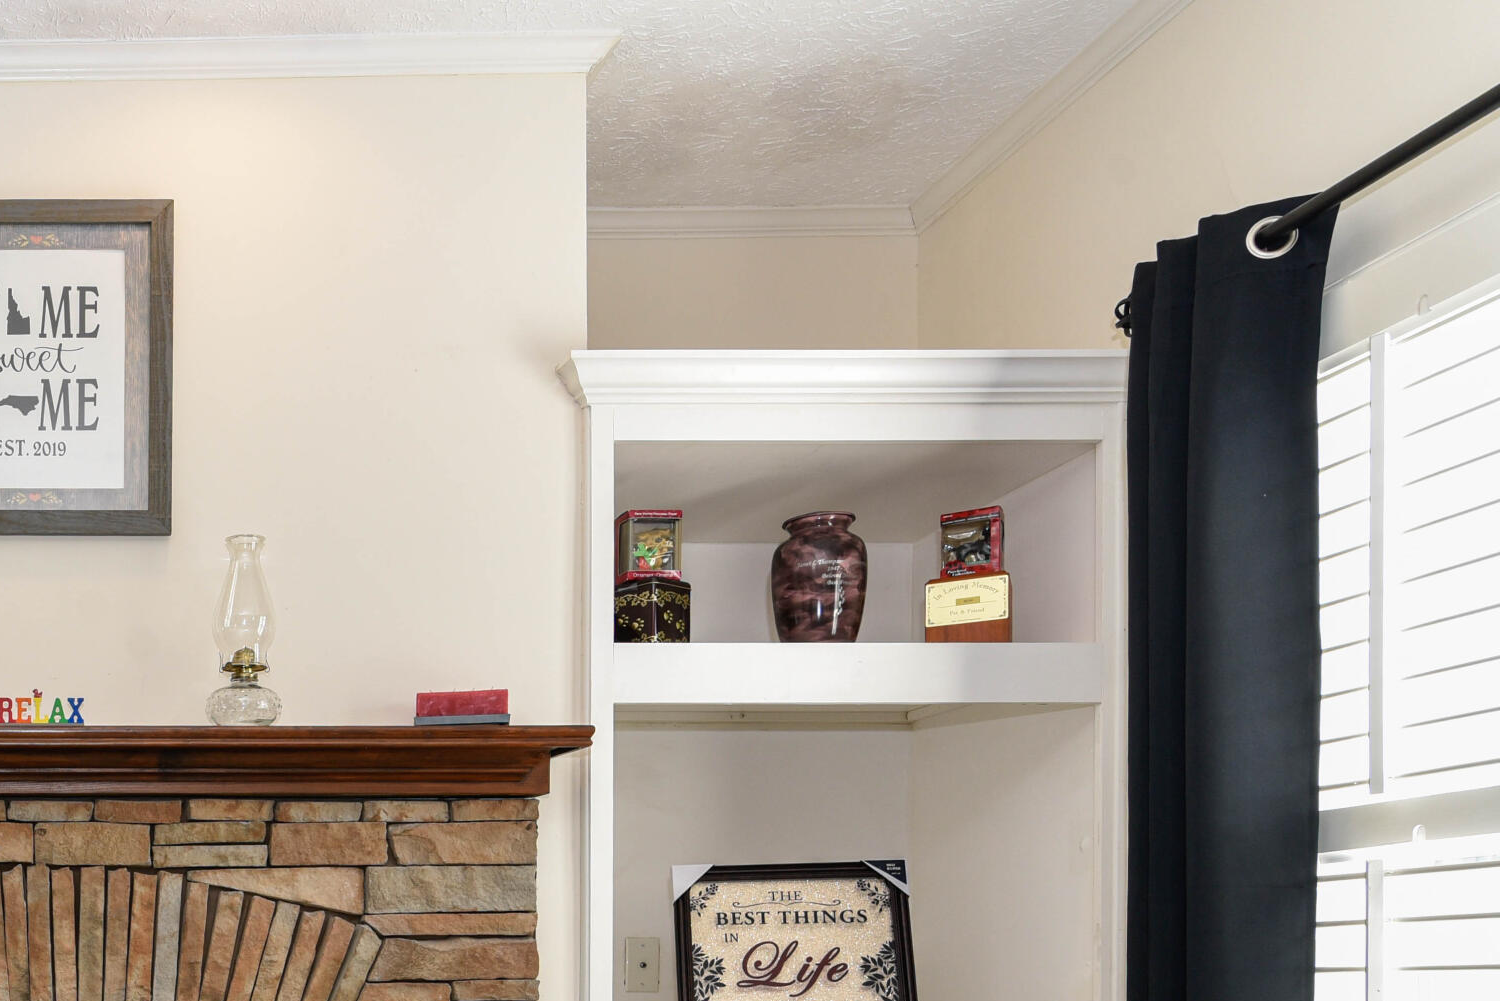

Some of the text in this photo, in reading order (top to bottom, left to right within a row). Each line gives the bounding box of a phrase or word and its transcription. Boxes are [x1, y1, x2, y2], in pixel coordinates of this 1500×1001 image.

[32, 440, 67, 457] 2019
[942, 583, 970, 595] Loving
[971, 581, 999, 593] Memory
[768, 890, 804, 902] THE
[716, 909, 868, 926] BEST THINGS
[724, 933, 739, 943] IN
[736, 940, 849, 998] Life
